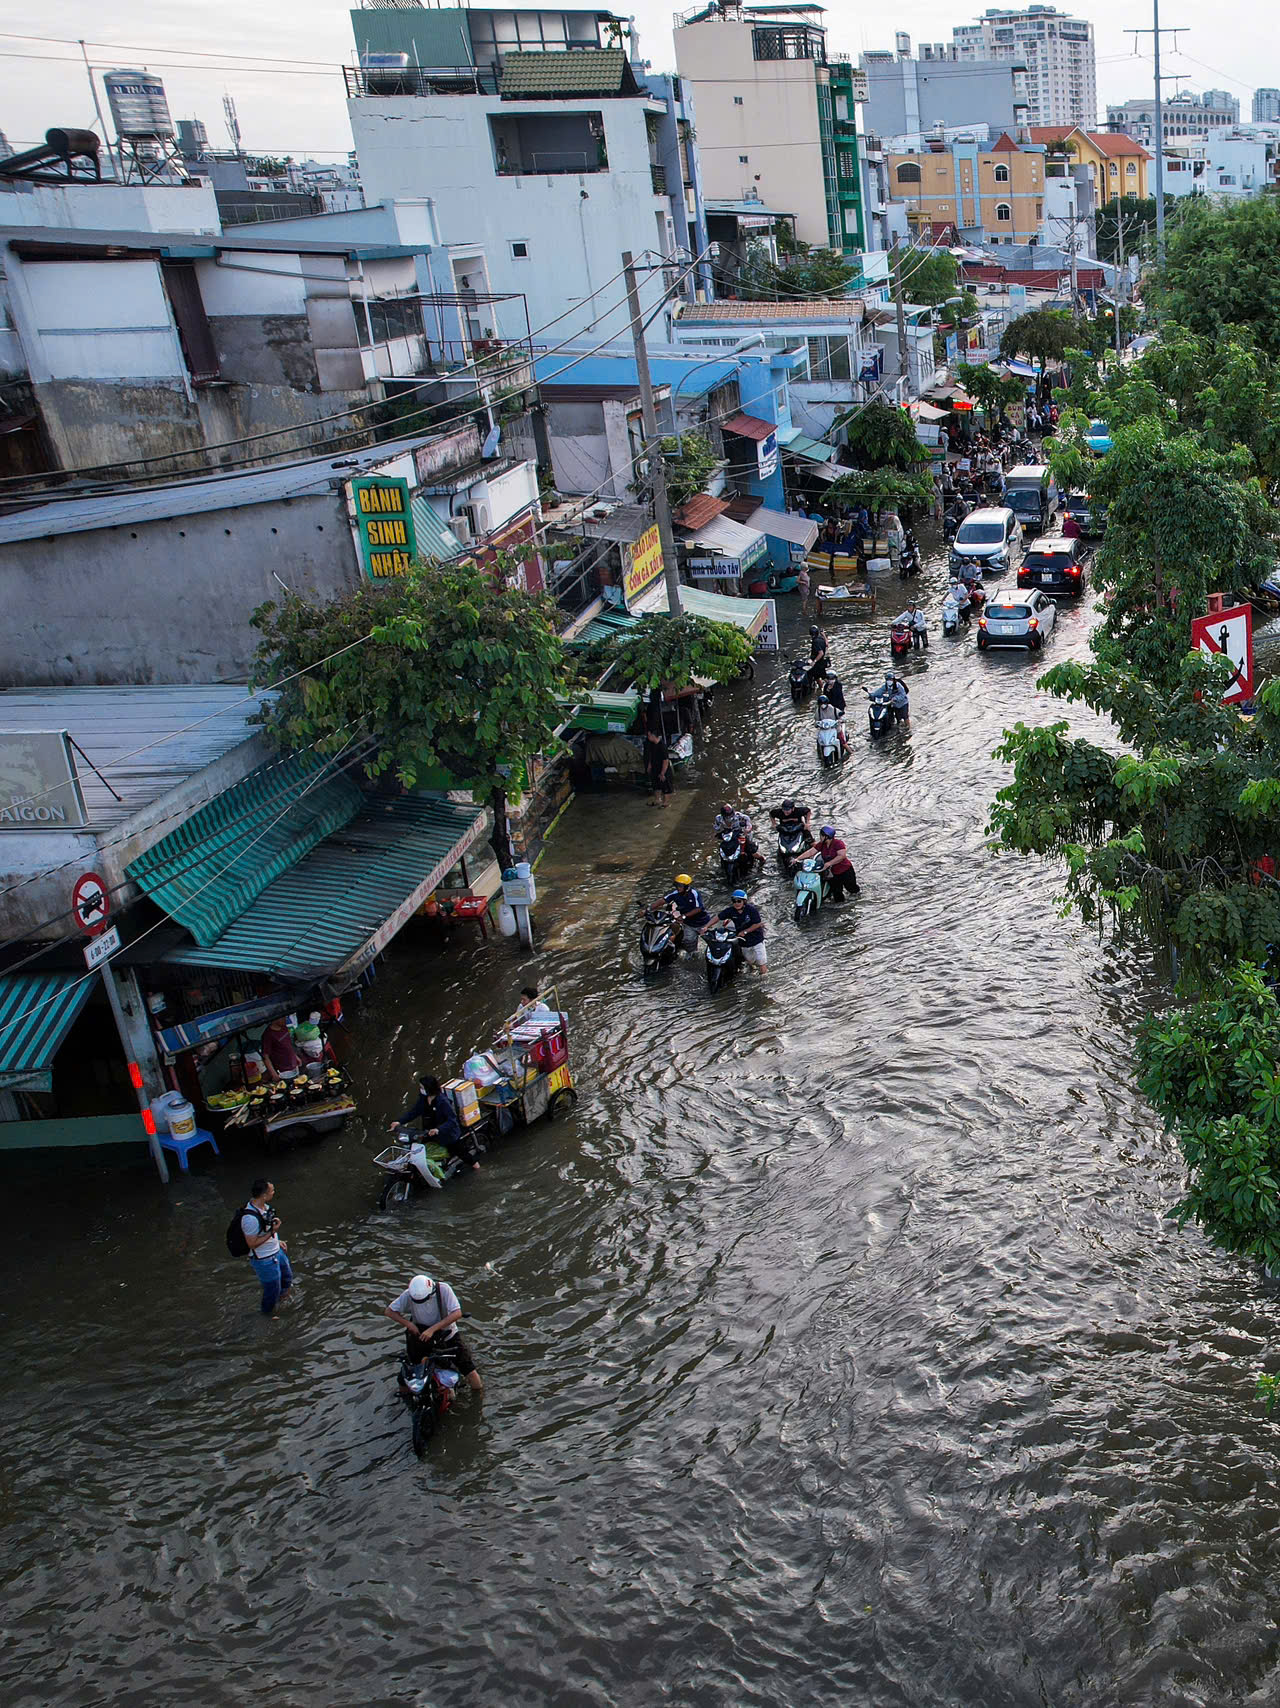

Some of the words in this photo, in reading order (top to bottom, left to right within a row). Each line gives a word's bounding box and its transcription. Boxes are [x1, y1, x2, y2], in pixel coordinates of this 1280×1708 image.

[359, 484, 402, 512] BÁNH
[367, 521, 406, 545] SINH
[693, 563, 705, 575] NHÀ
[707, 563, 727, 575] THUỐC
[728, 563, 739, 575] TÂY
[0, 806, 65, 821] AIGON
